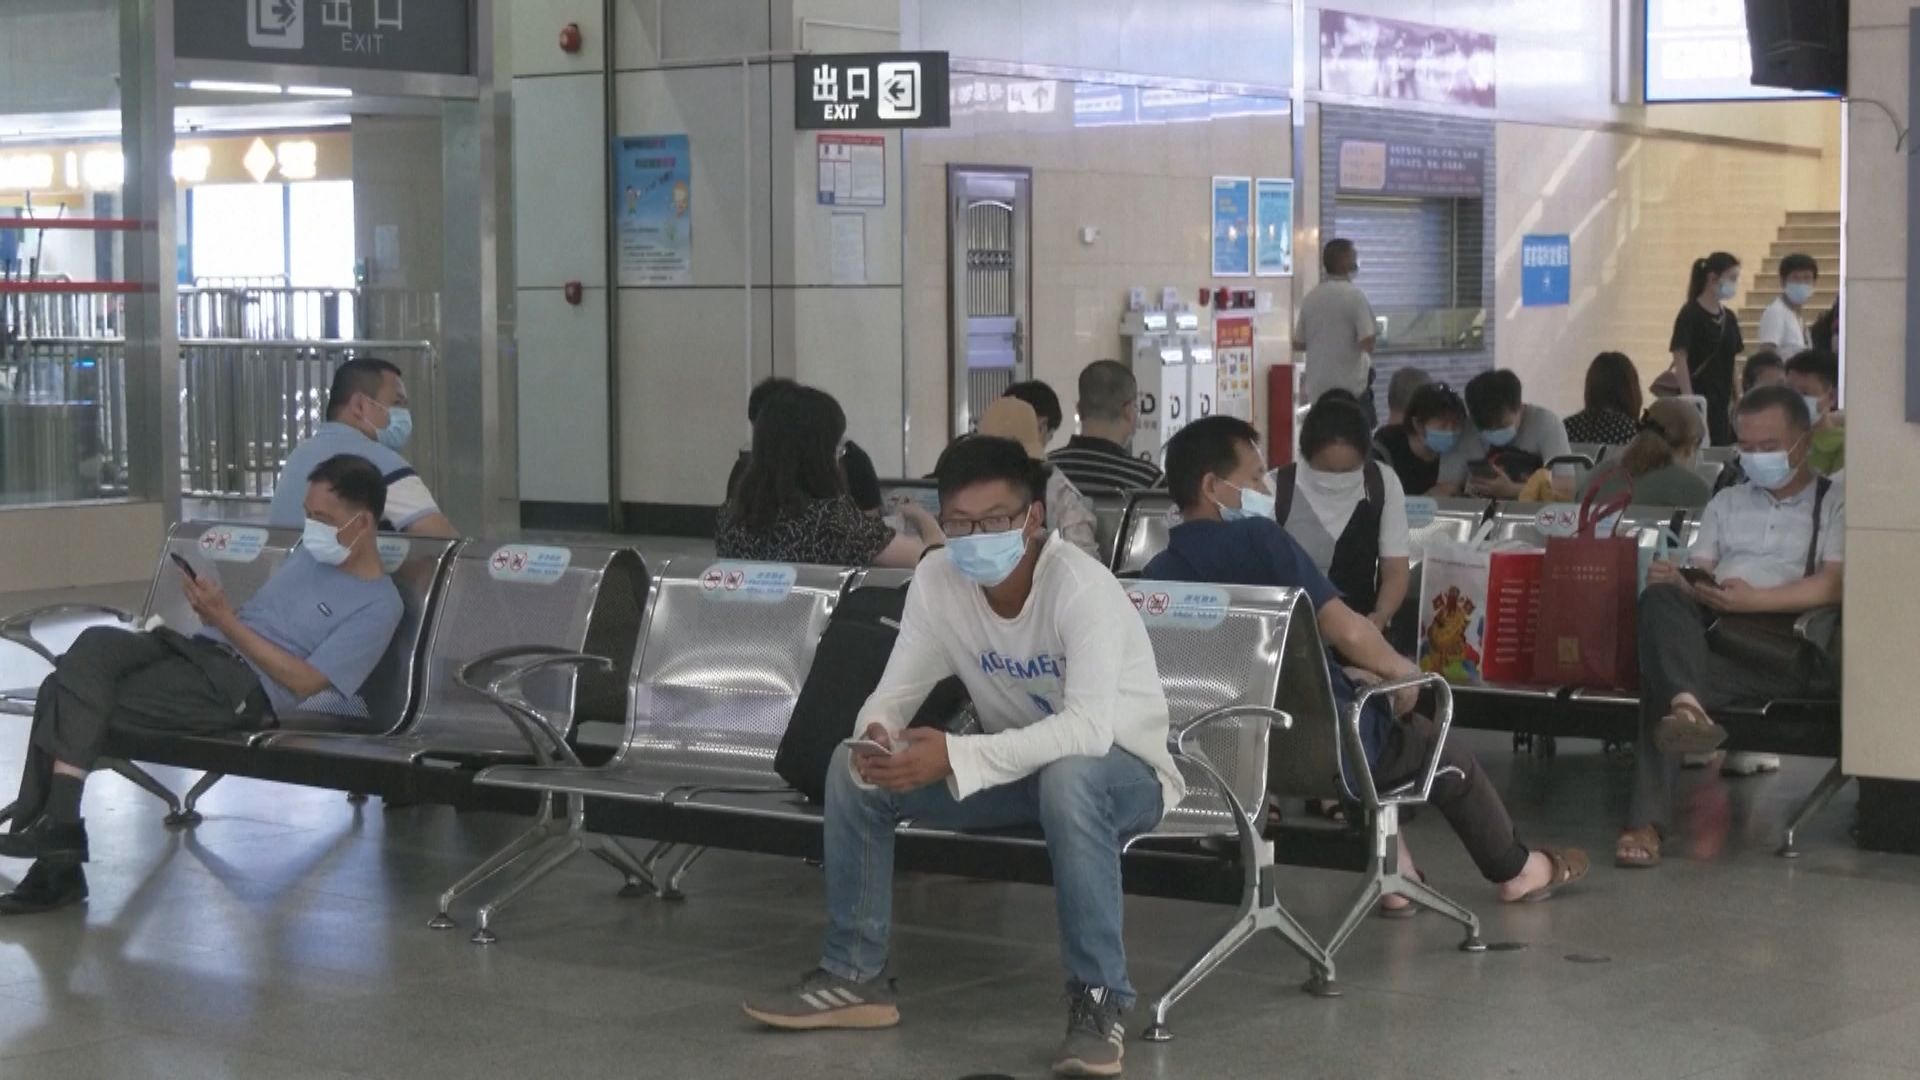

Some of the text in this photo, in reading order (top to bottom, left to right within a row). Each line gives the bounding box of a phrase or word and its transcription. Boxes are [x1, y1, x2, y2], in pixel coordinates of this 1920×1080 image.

[322, 0, 402, 30] 出口
[342, 32, 384, 54] EXIT
[813, 64, 870, 102] 出口
[824, 104, 859, 120] EXIT
